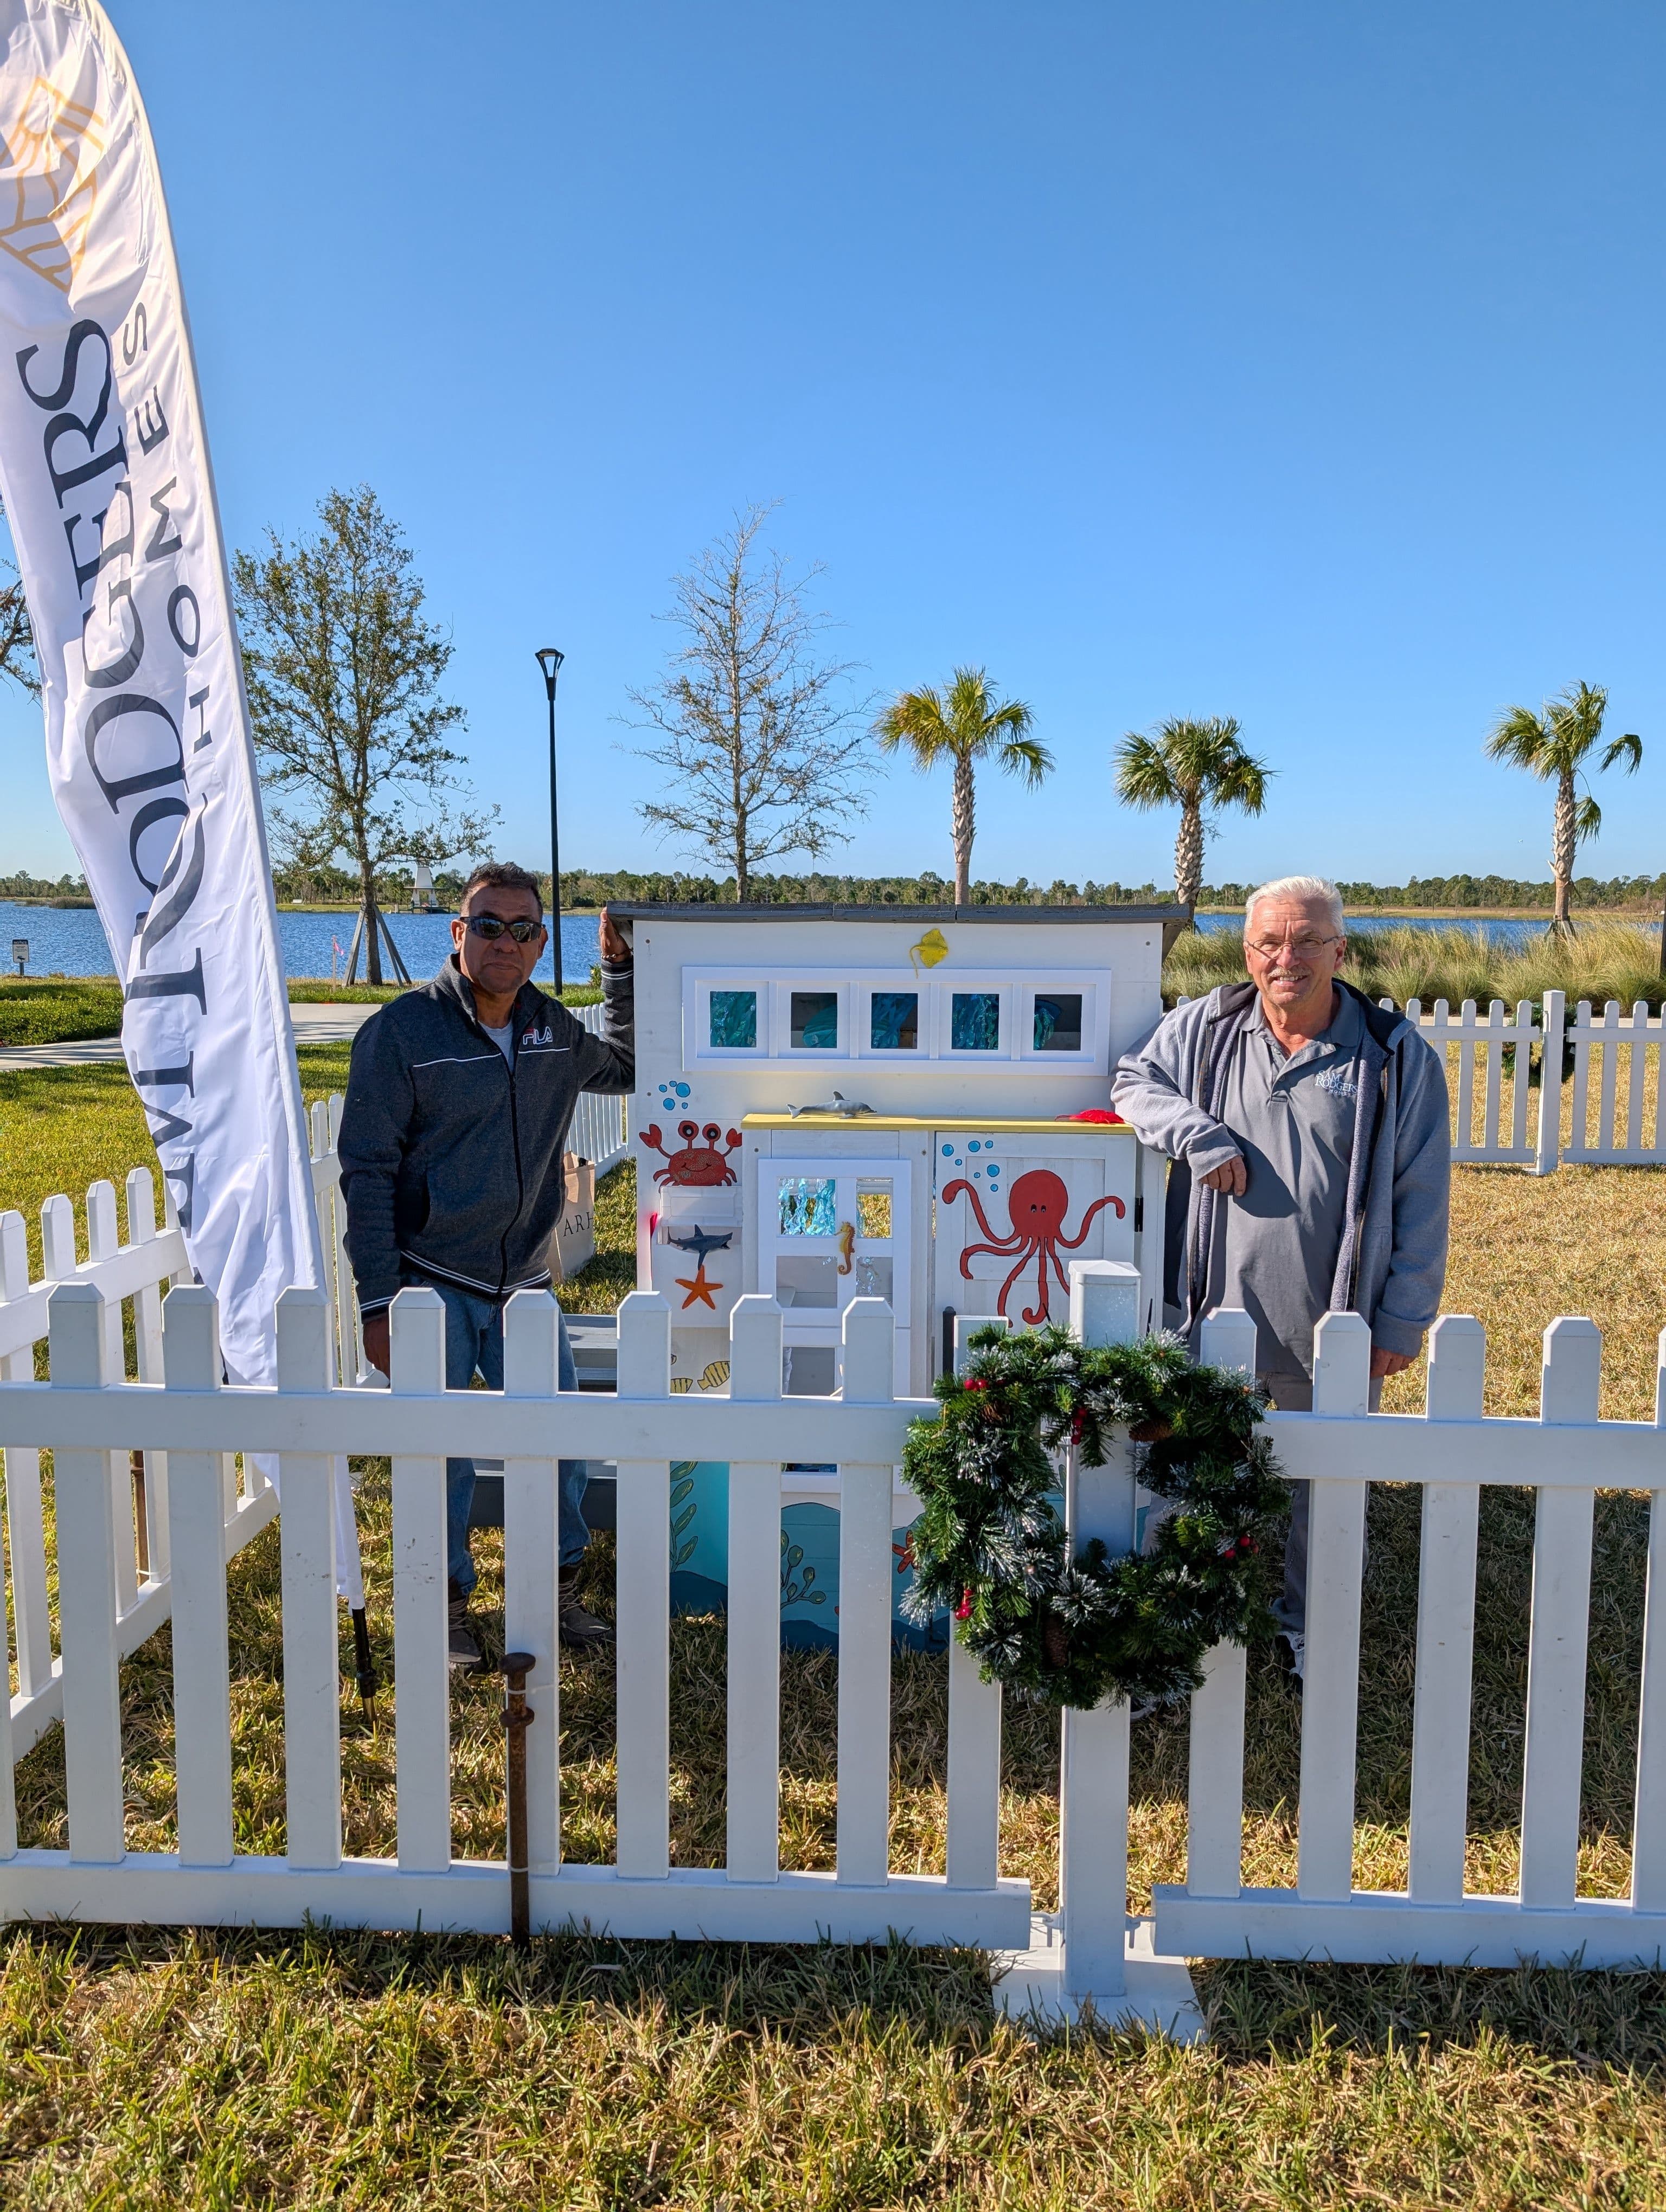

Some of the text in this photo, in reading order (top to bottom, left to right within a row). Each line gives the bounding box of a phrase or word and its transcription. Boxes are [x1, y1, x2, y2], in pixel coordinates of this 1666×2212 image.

[123, 301, 212, 754] HOMES
[523, 1026, 553, 1045] FILA
[1314, 1076, 1358, 1094] RODGERS
[1318, 1070, 1342, 1082] SAM
